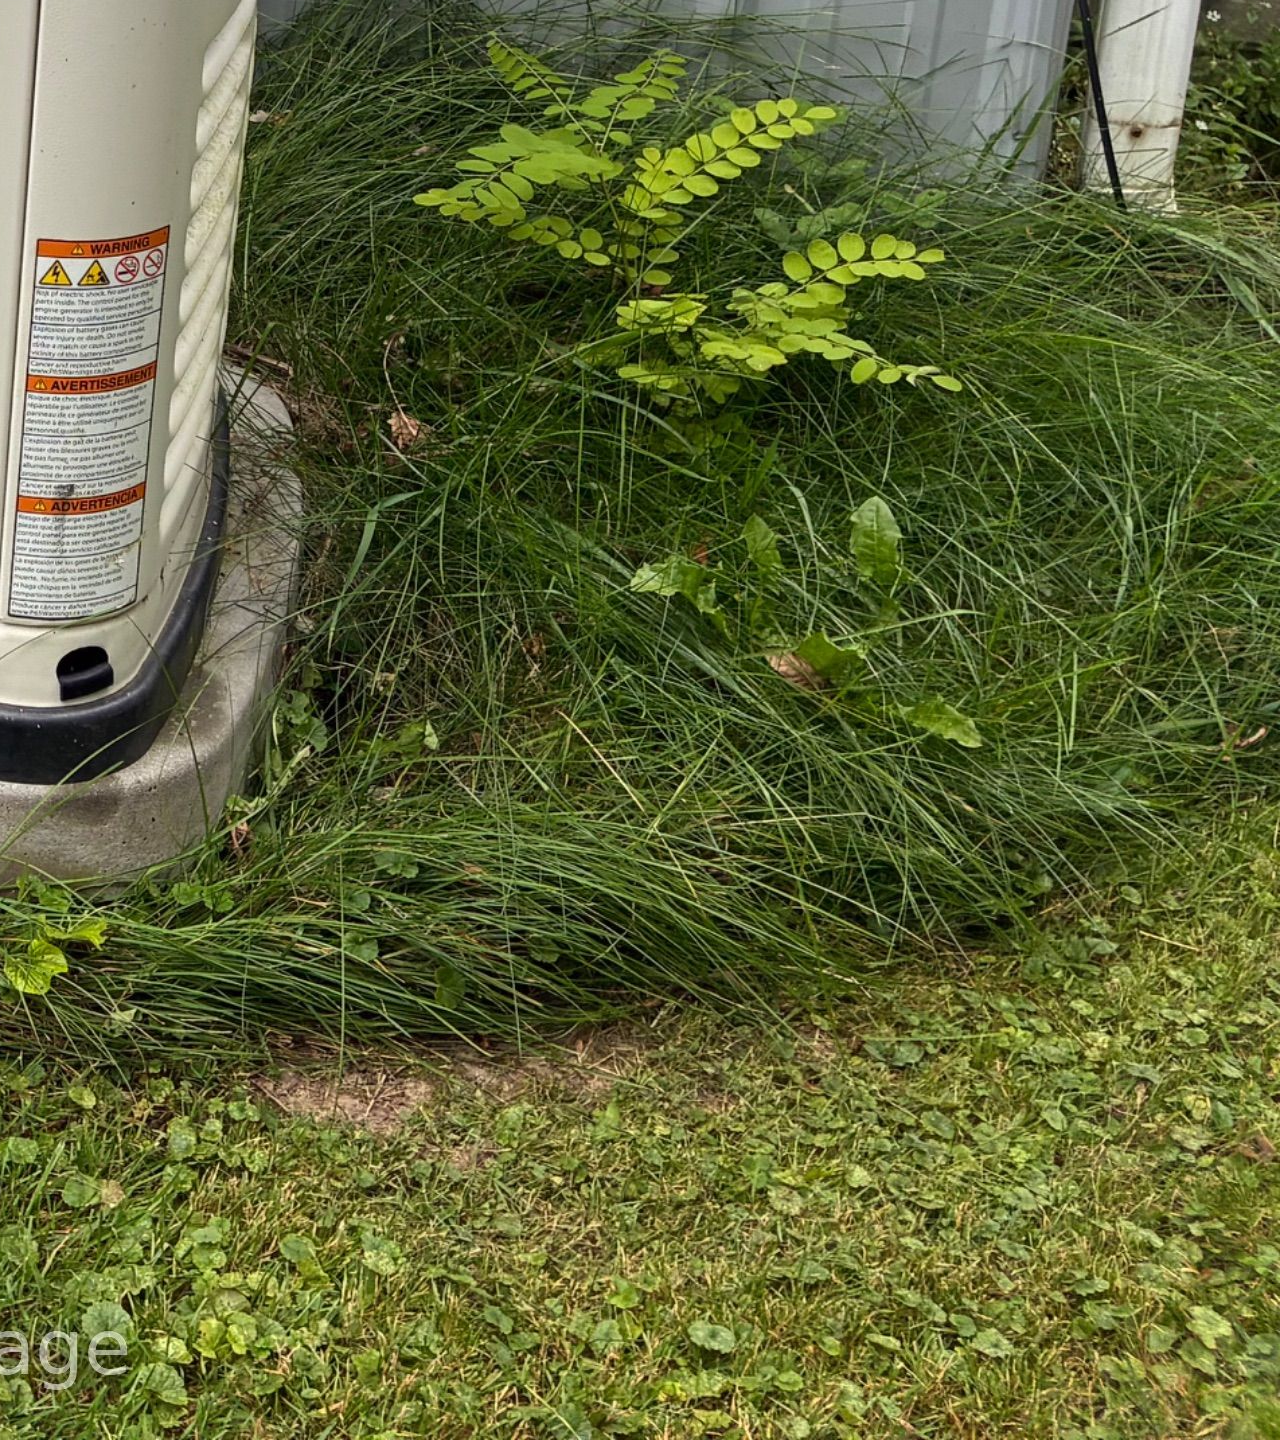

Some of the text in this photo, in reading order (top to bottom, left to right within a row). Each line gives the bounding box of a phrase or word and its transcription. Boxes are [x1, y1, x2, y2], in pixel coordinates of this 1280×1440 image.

[90, 236, 150, 255] WARNING
[51, 365, 153, 391] AVERTISSEMENT
[51, 489, 138, 512] ADVERTENCIA
